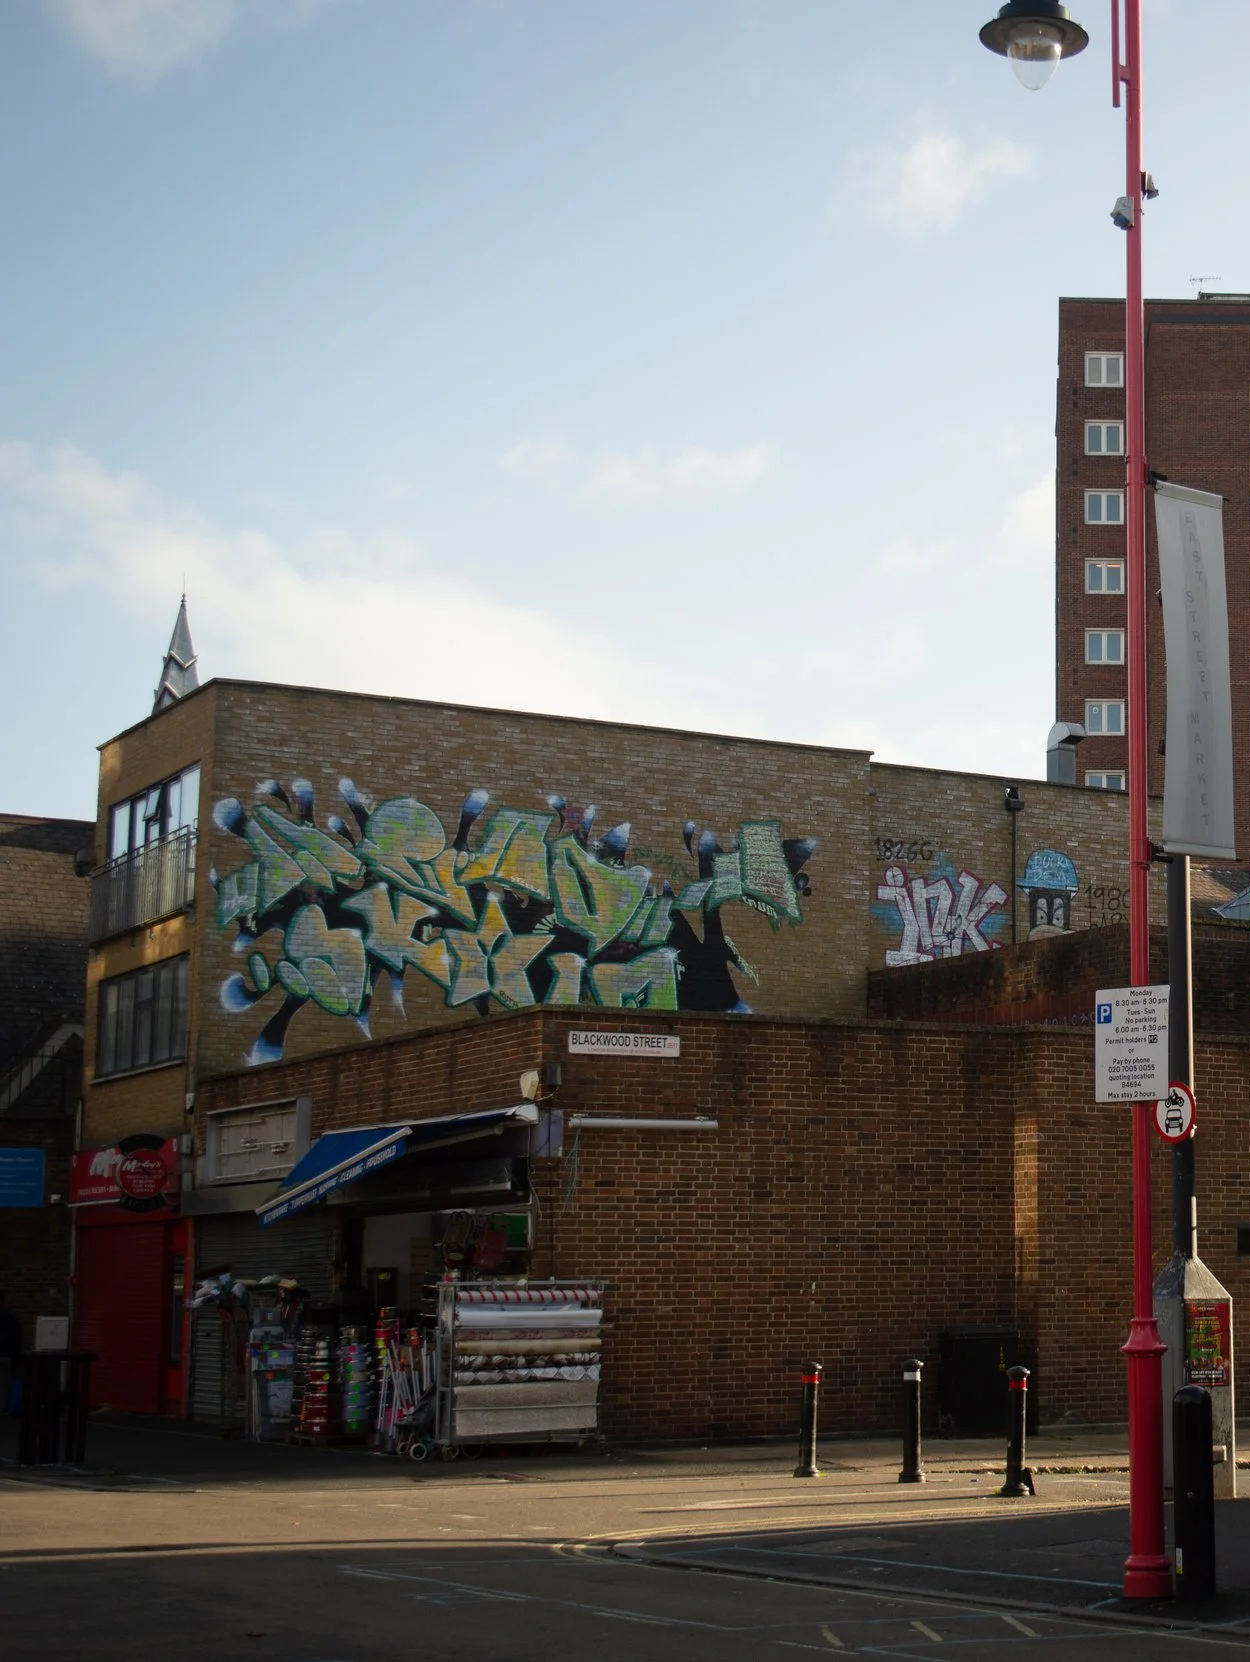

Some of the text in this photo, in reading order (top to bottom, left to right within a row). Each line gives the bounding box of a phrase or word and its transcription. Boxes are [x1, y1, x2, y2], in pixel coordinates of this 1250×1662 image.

[1184, 511, 1210, 826] EAST STREET MARKET
[1143, 1007, 1156, 1015] Sun
[1134, 1016, 1157, 1024] parking
[572, 1033, 631, 1047] BLACKWOOD
[633, 1036, 668, 1049] STREET
[1105, 1037, 1124, 1045] Permit
[1112, 1056, 1150, 1066] Pay by phone
[1108, 1065, 1121, 1073] 020
[1109, 1072, 1155, 1081] quoting location
[1121, 1091, 1133, 1099] stay
